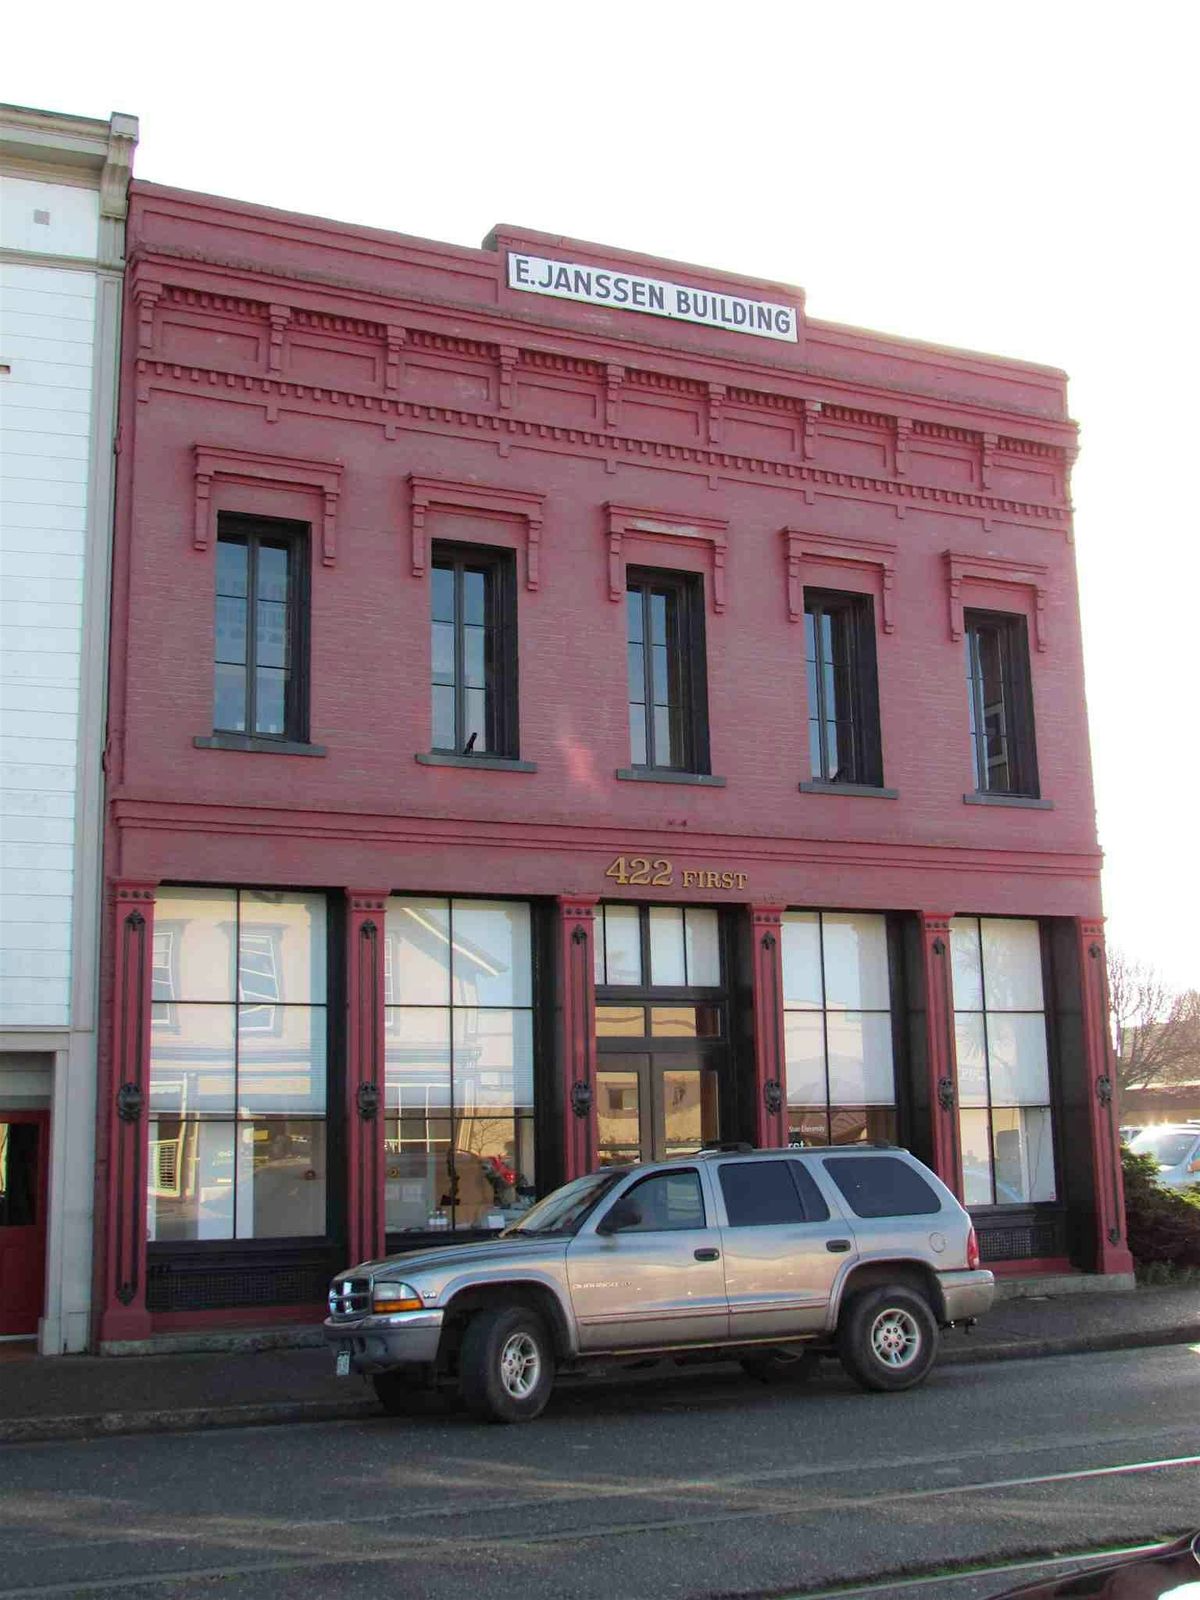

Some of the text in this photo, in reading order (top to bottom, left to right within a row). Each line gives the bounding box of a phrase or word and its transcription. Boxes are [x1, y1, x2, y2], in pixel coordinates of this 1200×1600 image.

[676, 290, 791, 334] BUILDING
[606, 857, 748, 890] 422 FIRST
